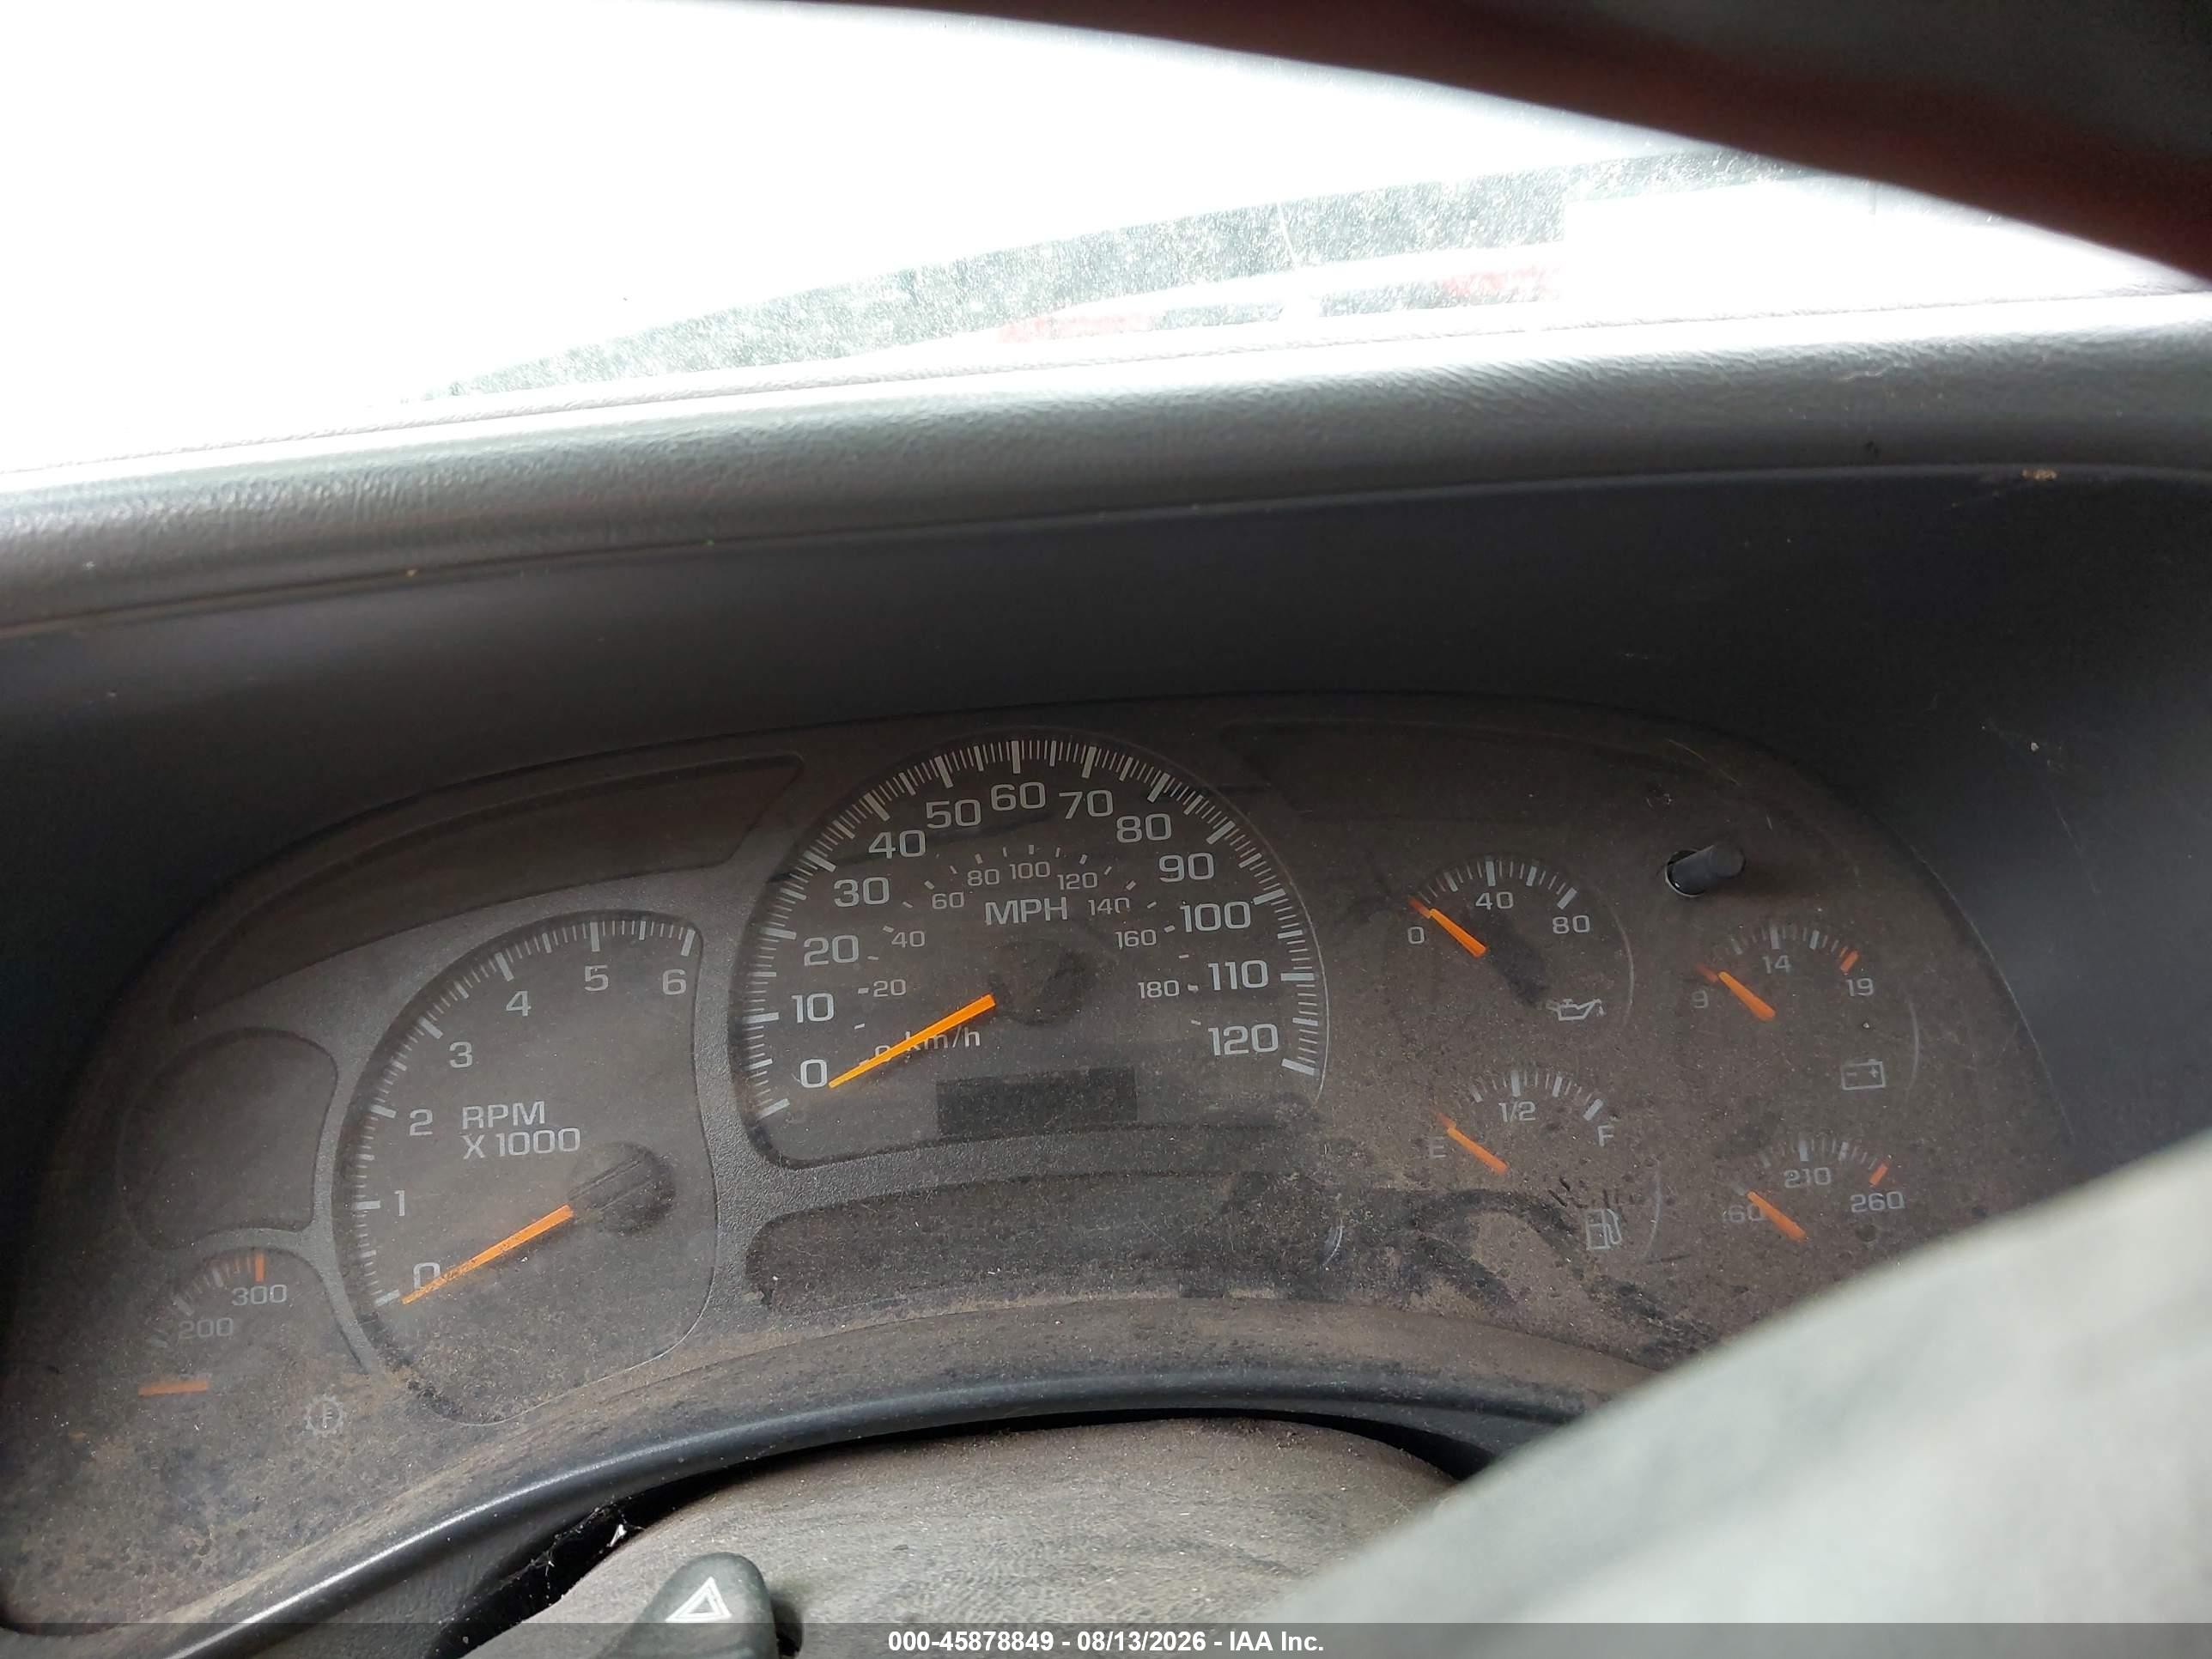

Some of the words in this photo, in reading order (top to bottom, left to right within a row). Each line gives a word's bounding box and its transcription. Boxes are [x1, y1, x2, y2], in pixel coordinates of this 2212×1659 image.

[990, 781, 1046, 811] 60
[1058, 789, 1114, 819] 70
[925, 799, 982, 830] 50
[1116, 813, 1172, 843] 80
[867, 830, 927, 860] 40
[967, 868, 1000, 886] 80
[1010, 861, 1052, 879] 100
[1057, 872, 1098, 890] 120
[1159, 853, 1215, 883] 90
[833, 877, 890, 908] 30
[931, 891, 965, 910] 60
[1088, 897, 1131, 915] 140
[1474, 891, 1515, 911] 40
[985, 896, 1068, 926] MPH
[1181, 902, 1251, 933] 100
[1552, 915, 1590, 934] 80
[890, 930, 927, 949] 40
[1115, 928, 1158, 950] 160
[1407, 926, 1425, 945] 0
[803, 934, 860, 967] 20
[583, 964, 609, 992] 5
[1207, 959, 1269, 991] 110
[1762, 954, 1793, 975] 14
[660, 968, 688, 995] 6
[872, 979, 907, 997] 20
[1137, 979, 1180, 1000] 180
[1845, 977, 1875, 997] 19
[505, 990, 532, 1017] 4
[791, 993, 836, 1024] 10
[1690, 989, 1710, 1009] 9
[1207, 1024, 1279, 1056] 120
[448, 1041, 474, 1069] 3
[799, 1059, 829, 1089] 0
[409, 1109, 434, 1136] 2
[461, 1101, 546, 1130] RPM
[1498, 1100, 1536, 1123] 1/2
[461, 1133, 487, 1160] X
[495, 1127, 581, 1157] 1000
[1428, 1136, 1446, 1158] E
[1596, 1124, 1615, 1147] F
[1784, 1166, 1832, 1189] 210
[395, 1189, 406, 1217] 1
[1850, 1190, 1905, 1213] 260
[412, 1262, 441, 1291] 0
[231, 1284, 288, 1306] 300
[178, 1317, 234, 1340] 200
